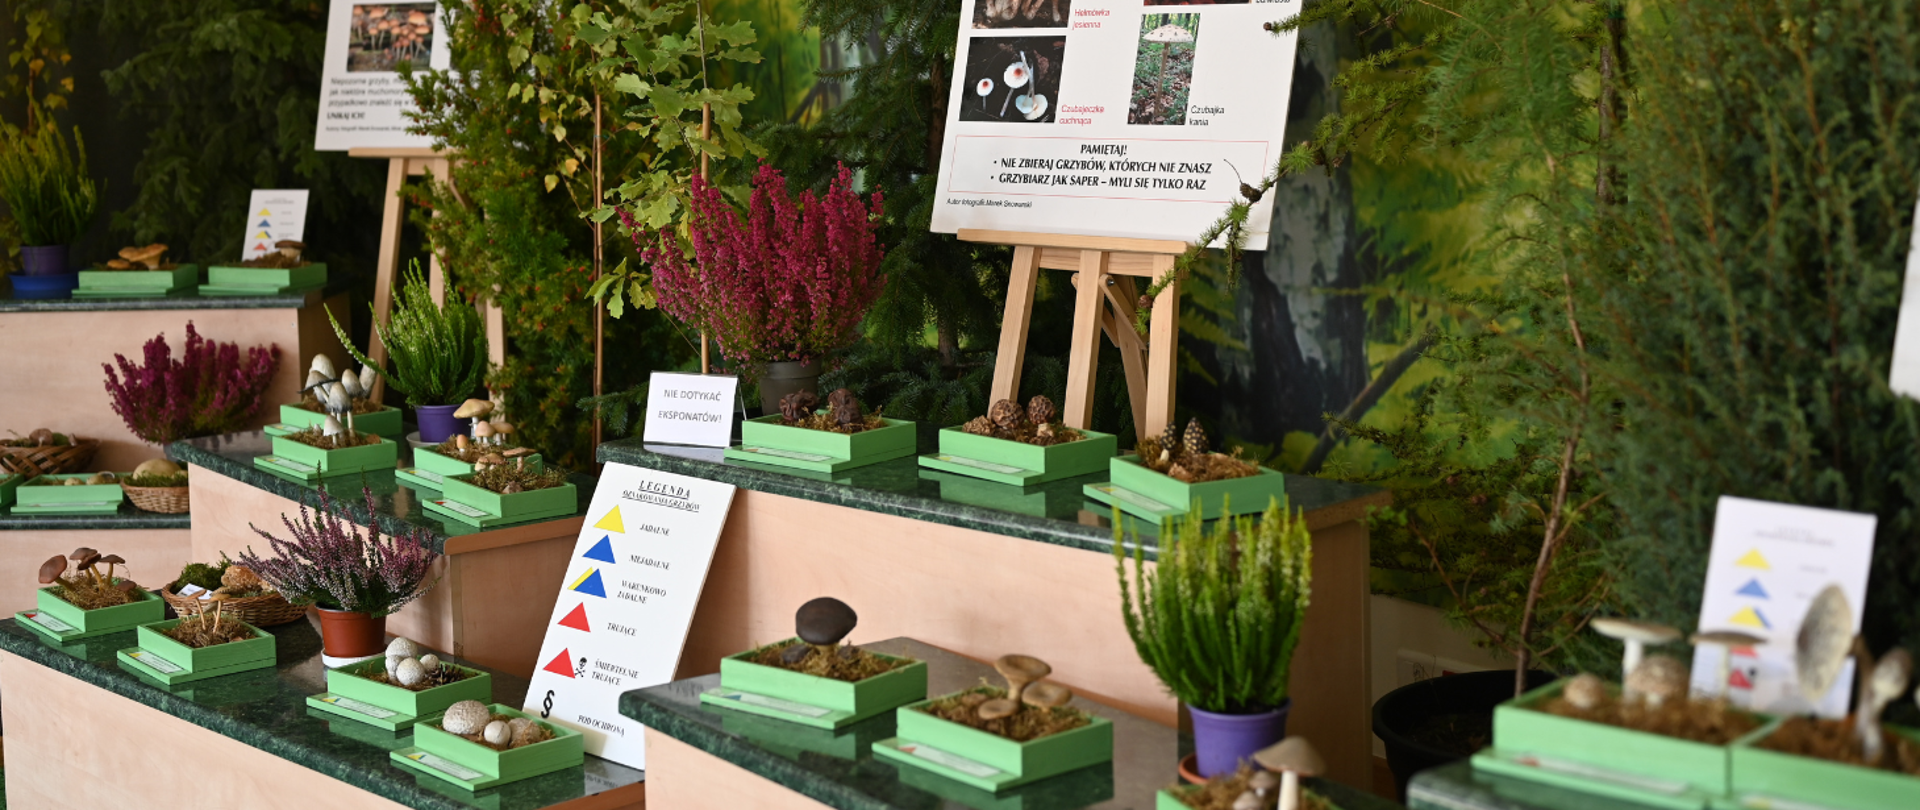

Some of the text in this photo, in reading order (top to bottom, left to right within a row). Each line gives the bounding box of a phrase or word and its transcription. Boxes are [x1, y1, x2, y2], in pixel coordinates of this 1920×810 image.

[1072, 21, 1101, 30] jesienna
[1191, 105, 1225, 116] Czubajka
[1189, 117, 1209, 126] kania
[1001, 157, 1212, 174] NIE ZBIERAJ GRZYBÓW, KTÓRYCH NIE ZNASZ
[999, 173, 1050, 185] GRZYBIARZ
[1051, 174, 1068, 186] JAK
[1069, 175, 1099, 187] SAPER
[1108, 176, 1132, 188] MYLI
[1134, 177, 1150, 189] SIĘ
[1152, 177, 1184, 189] TYLKO
[1185, 179, 1206, 190] RAZ
[664, 389, 721, 401] NIE DOTYKAĆ
[658, 410, 722, 423] EKSPONATÓW!
[638, 480, 690, 499] LEGENDA
[640, 523, 670, 536] JADALNE
[629, 554, 670, 570] NIEJADALNE
[622, 579, 667, 597] WARUNKOWO
[607, 622, 638, 636] TRUJĄCE
[595, 658, 639, 678] ŚMIERTELNIE
[592, 671, 621, 685] TRUJĄCE
[578, 714, 625, 737] POD OCHRONĄ
